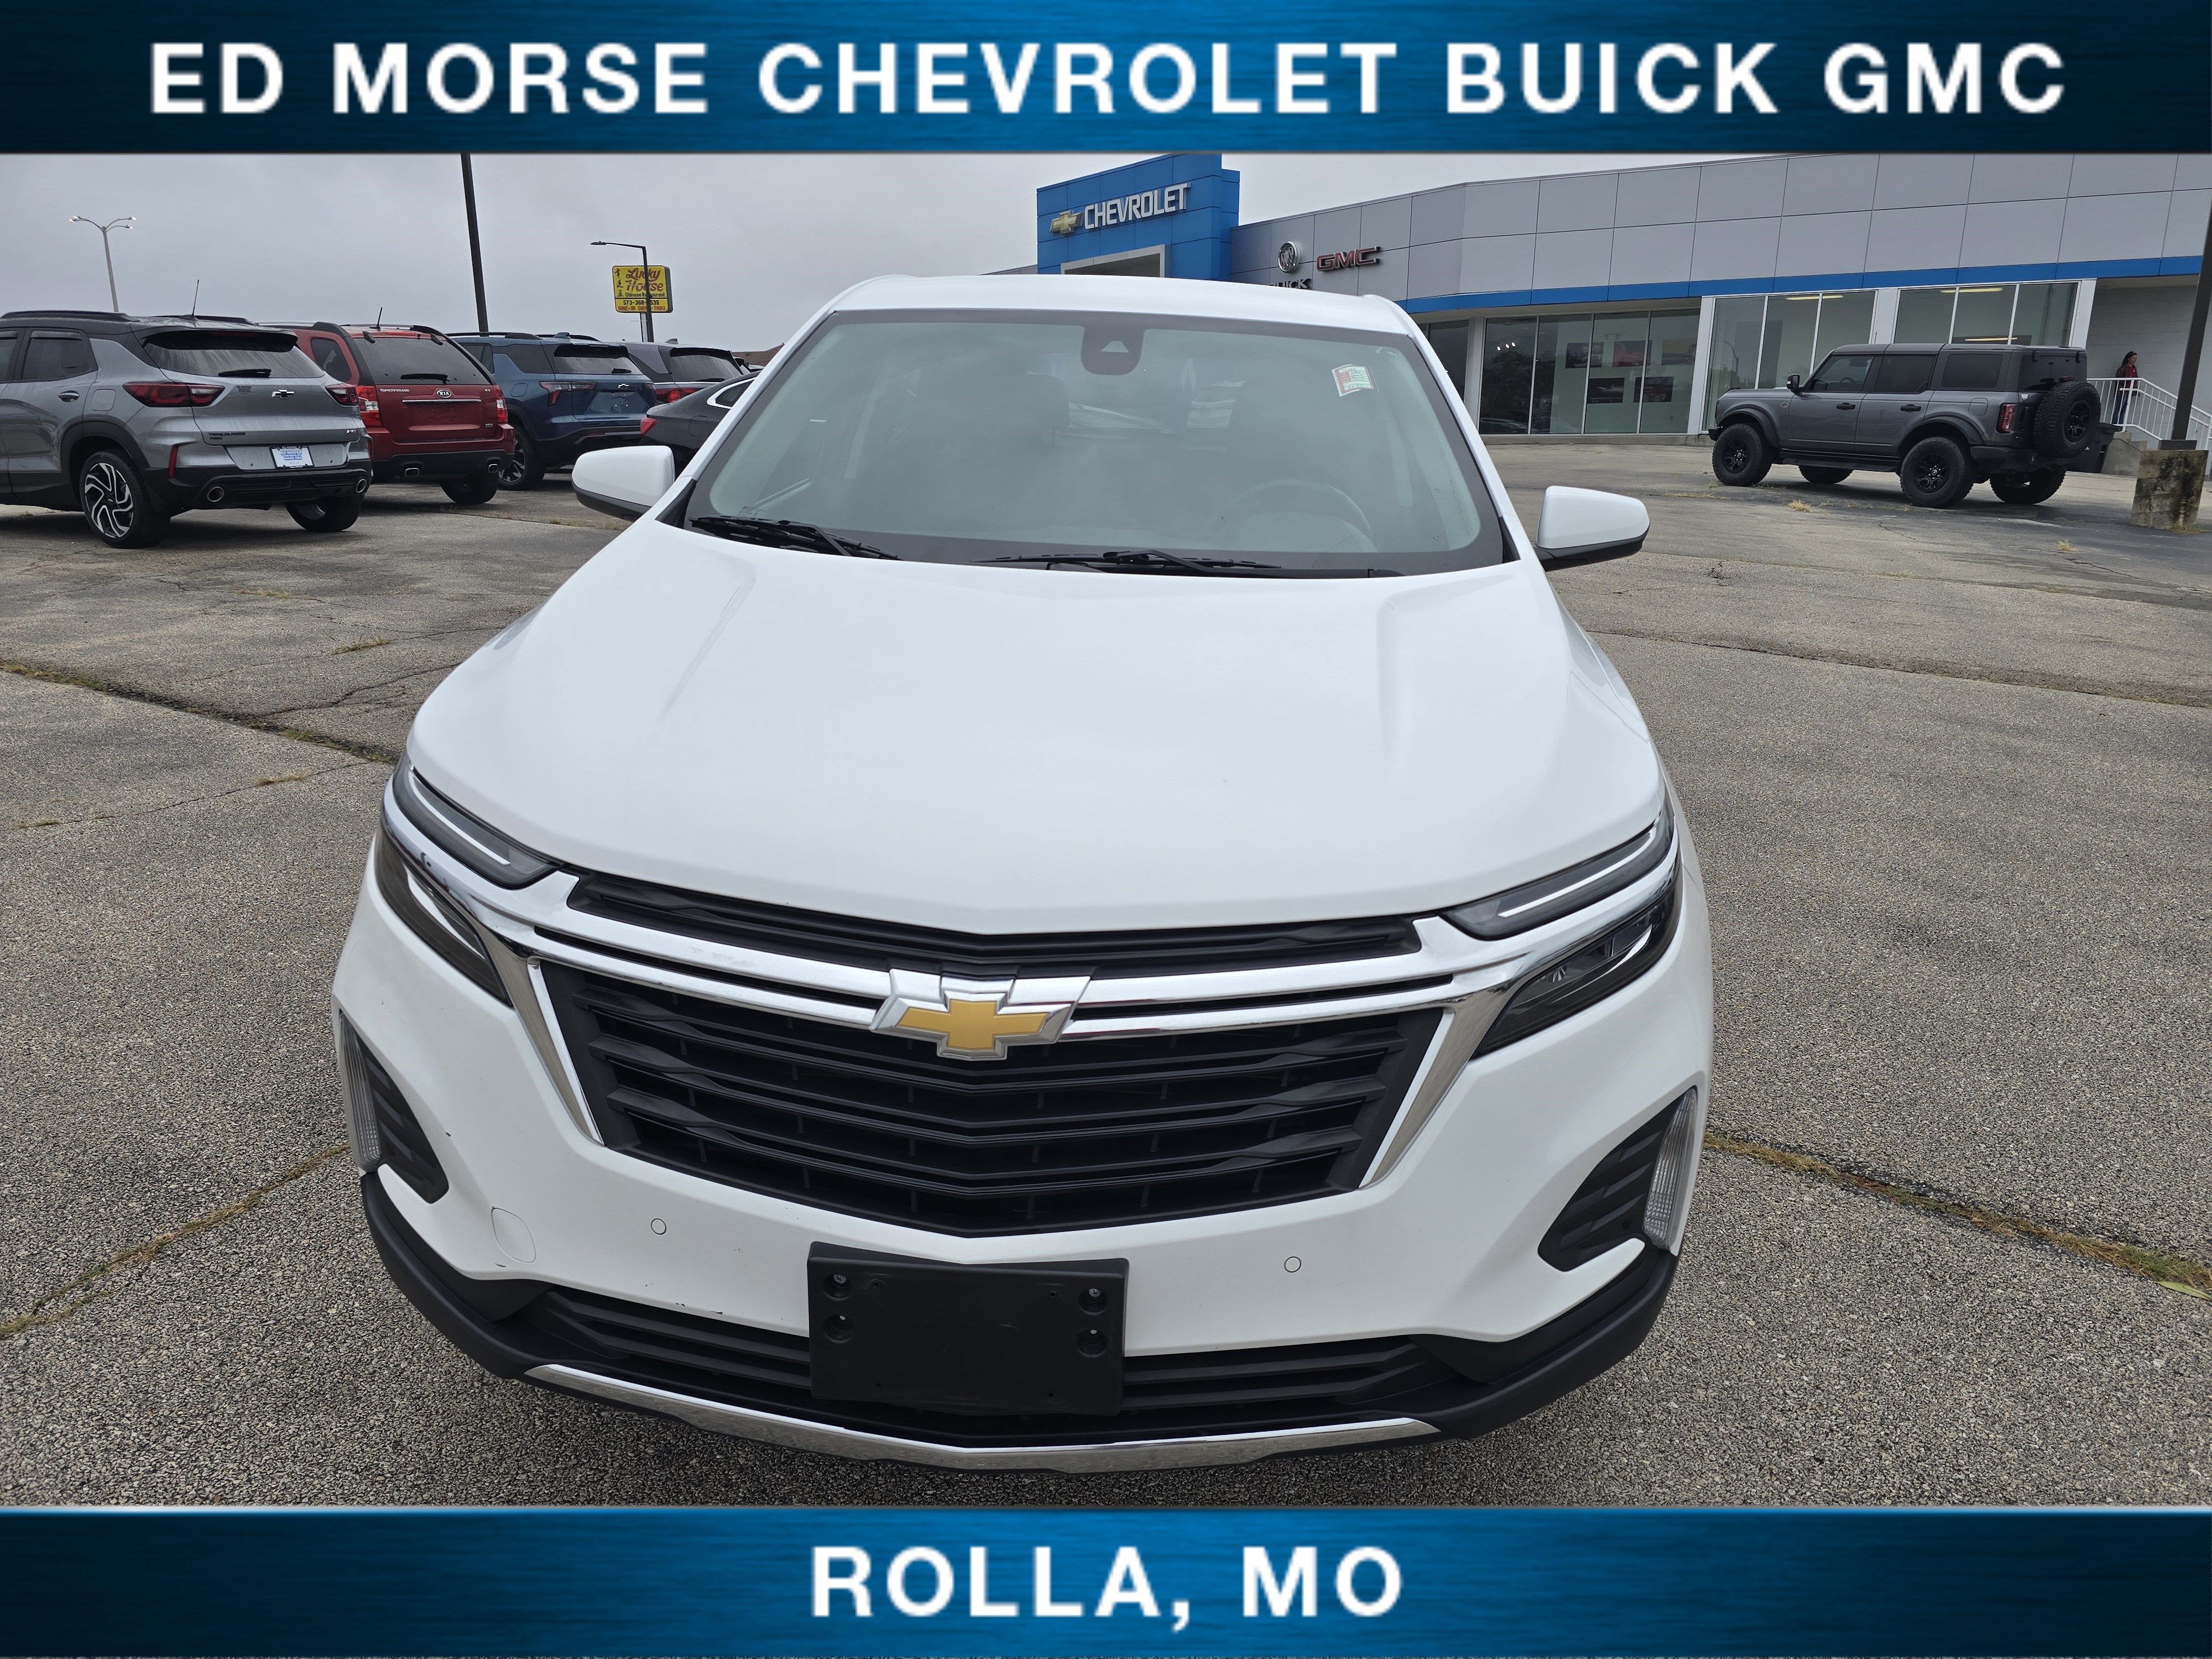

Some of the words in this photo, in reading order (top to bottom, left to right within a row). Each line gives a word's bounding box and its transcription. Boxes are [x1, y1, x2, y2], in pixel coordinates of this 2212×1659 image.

[1084, 182, 1190, 229] CHEVROLET
[1317, 246, 1379, 271] GMC
[1270, 278, 1311, 289] ICK
